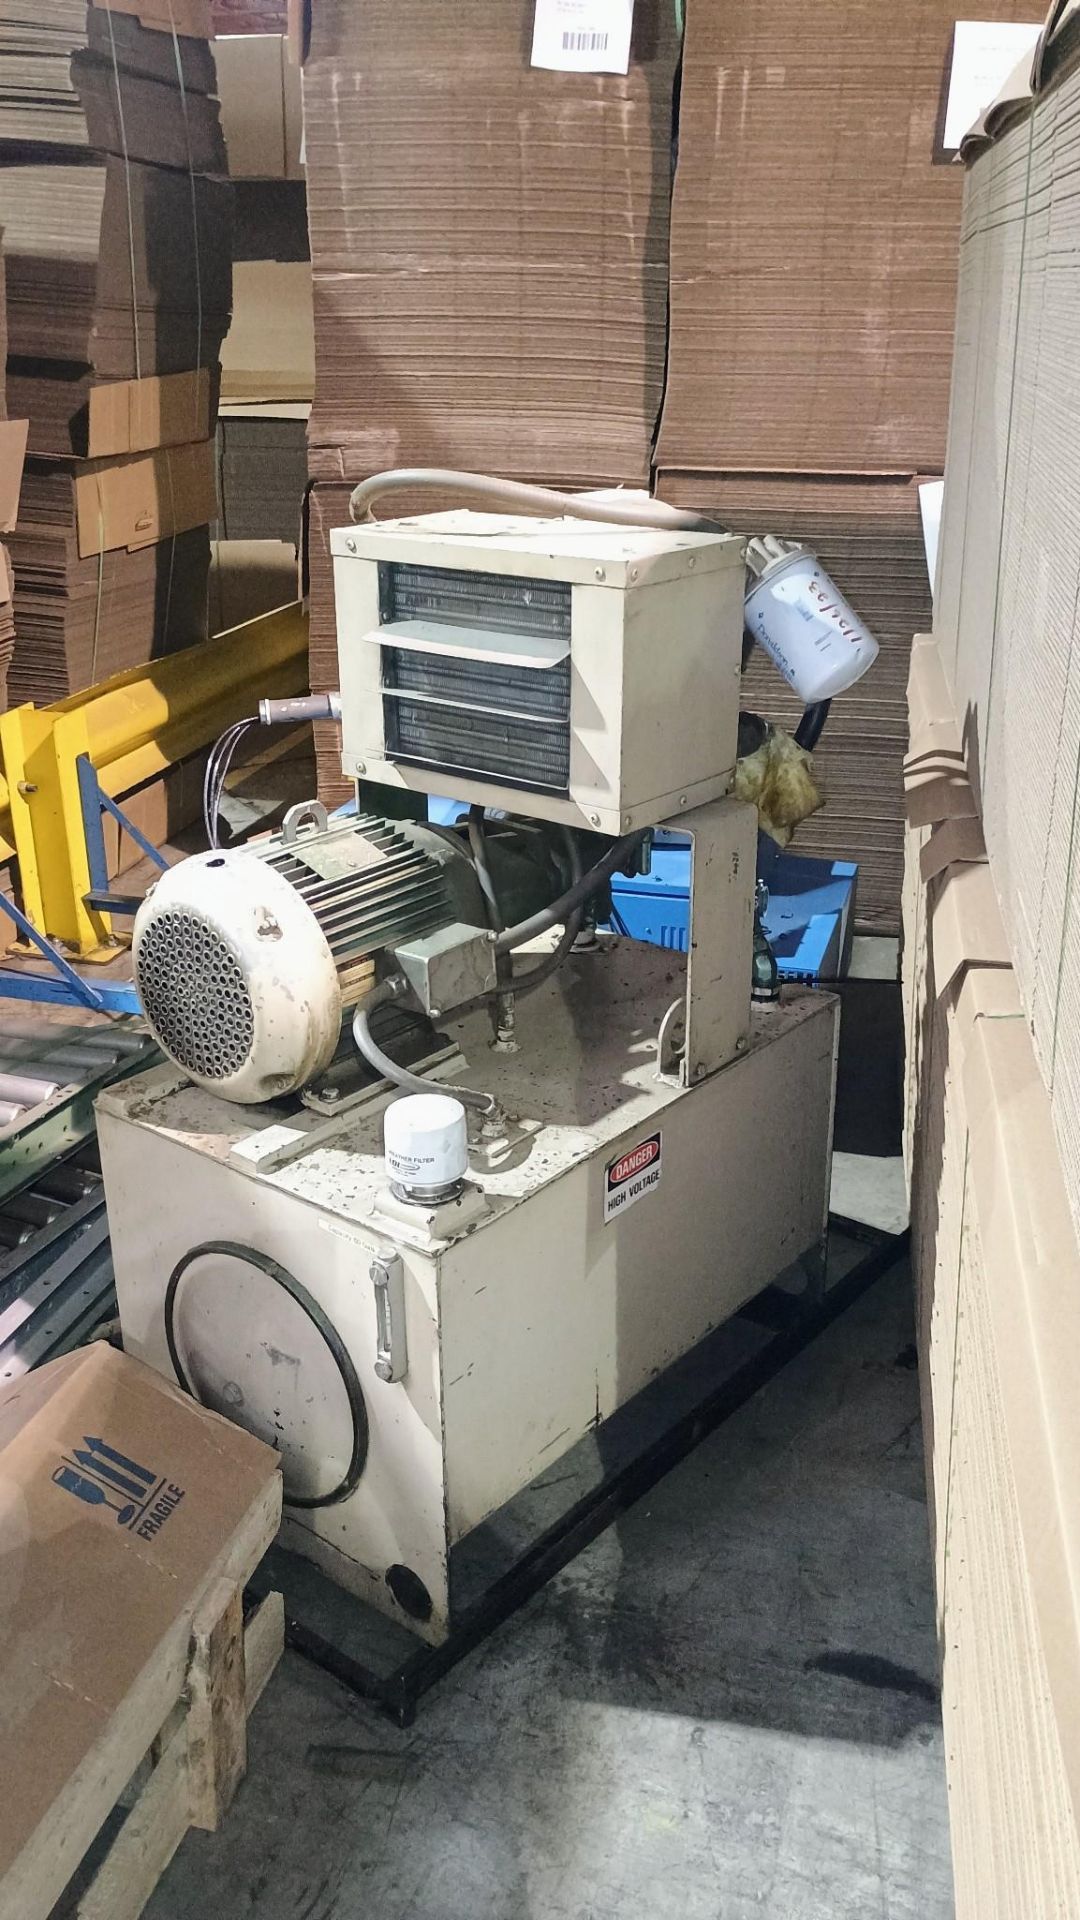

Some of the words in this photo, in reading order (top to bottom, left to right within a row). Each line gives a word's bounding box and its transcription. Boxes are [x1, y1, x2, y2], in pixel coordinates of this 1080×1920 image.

[615, 1144, 653, 1180] DANGER
[607, 1191, 627, 1212] HIGH
[628, 1170, 660, 1197] VOLTAGE
[136, 1483, 186, 1543] FRAGILE
